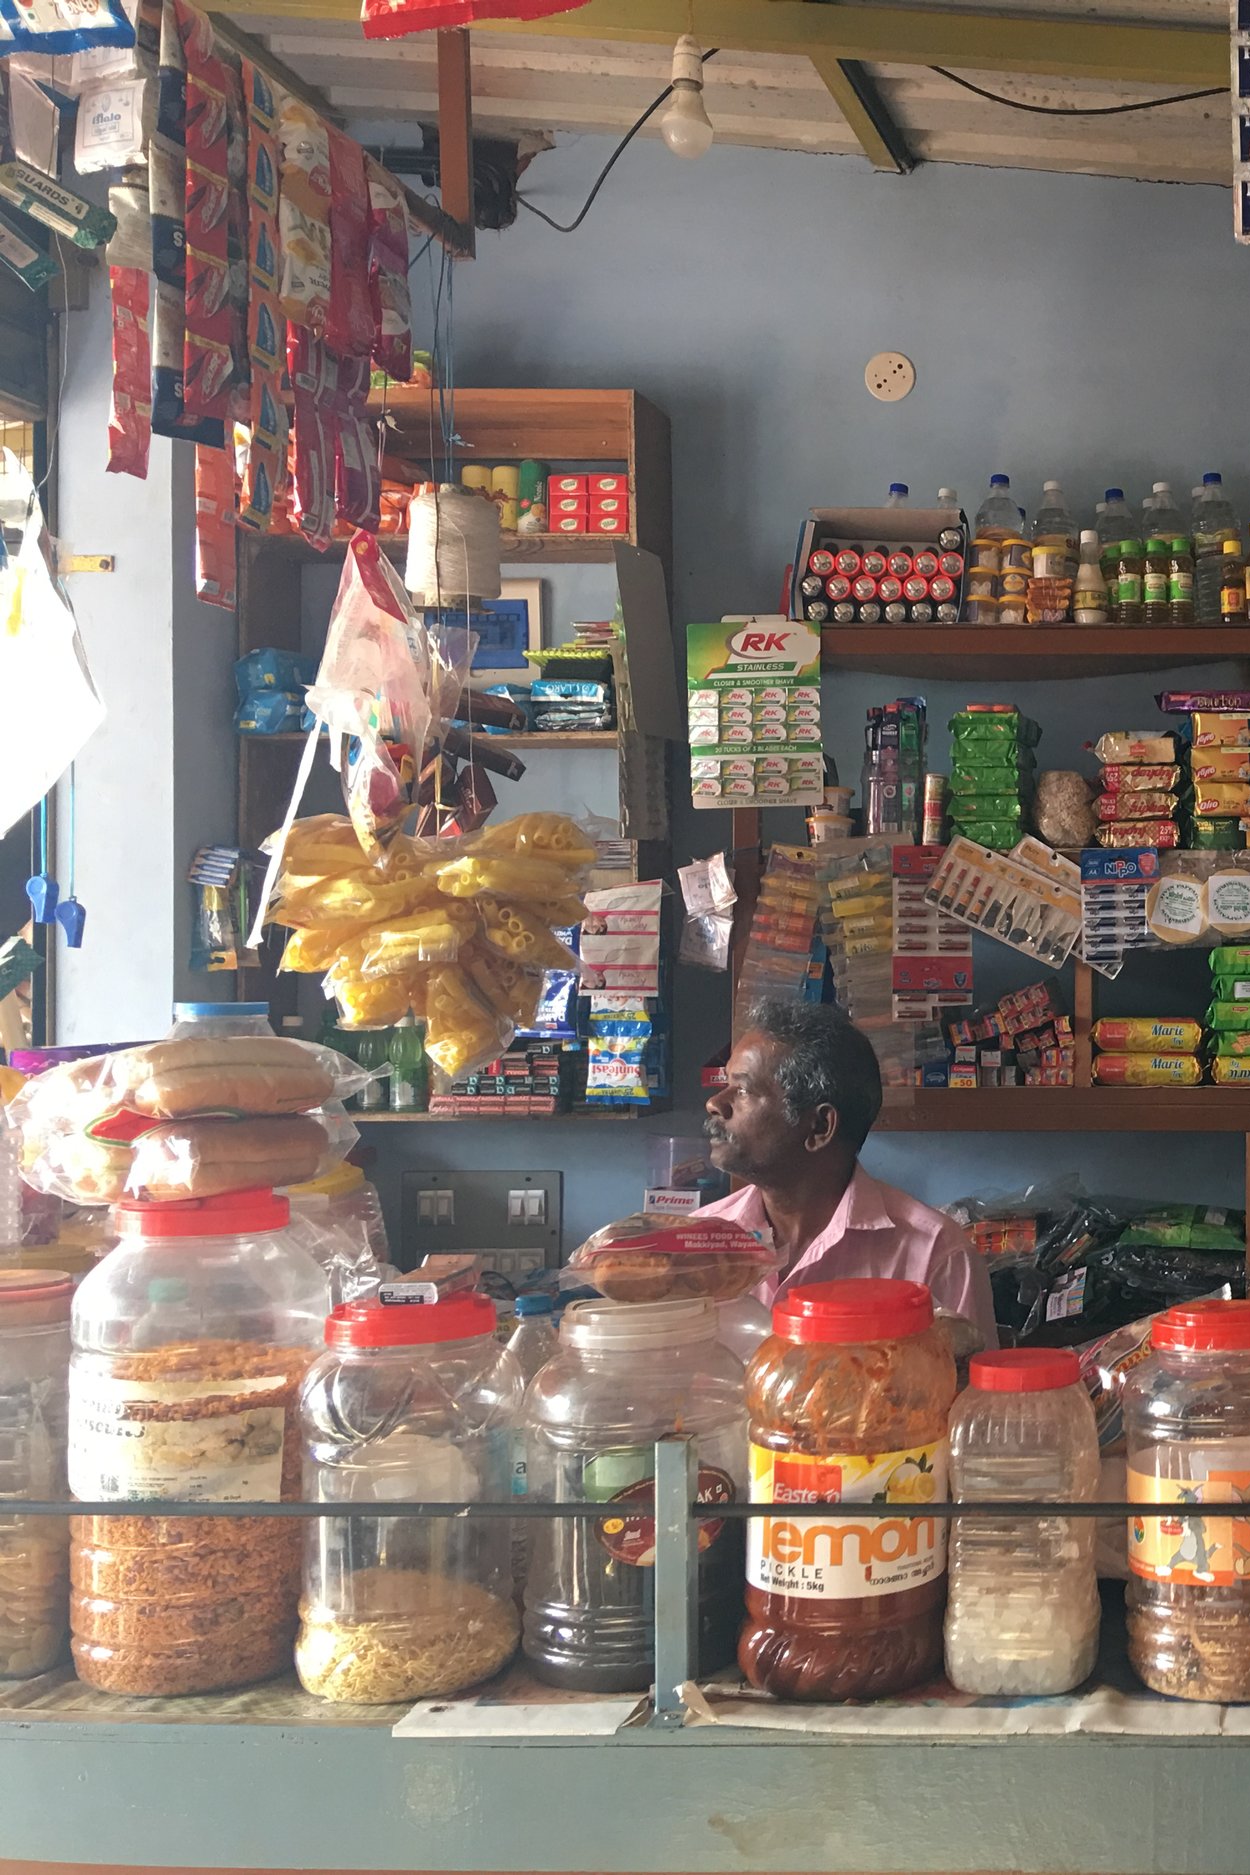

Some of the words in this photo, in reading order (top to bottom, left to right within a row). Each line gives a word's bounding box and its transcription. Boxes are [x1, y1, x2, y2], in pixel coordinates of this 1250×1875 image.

[741, 632, 791, 652] RK
[737, 663, 784, 672] STAINLESS
[1105, 861, 1136, 877] NIPPO
[1151, 1023, 1185, 1036] Marie
[1151, 1057, 1185, 1069] Marie
[591, 1064, 641, 1077] Sunfeast
[656, 1195, 694, 1205] Prime
[763, 1515, 934, 1567] lemon
[761, 1560, 823, 1580] PICKLE
[761, 1573, 770, 1584] Net
[772, 1576, 799, 1590] Weight
[806, 1581, 824, 1592] 5kg
